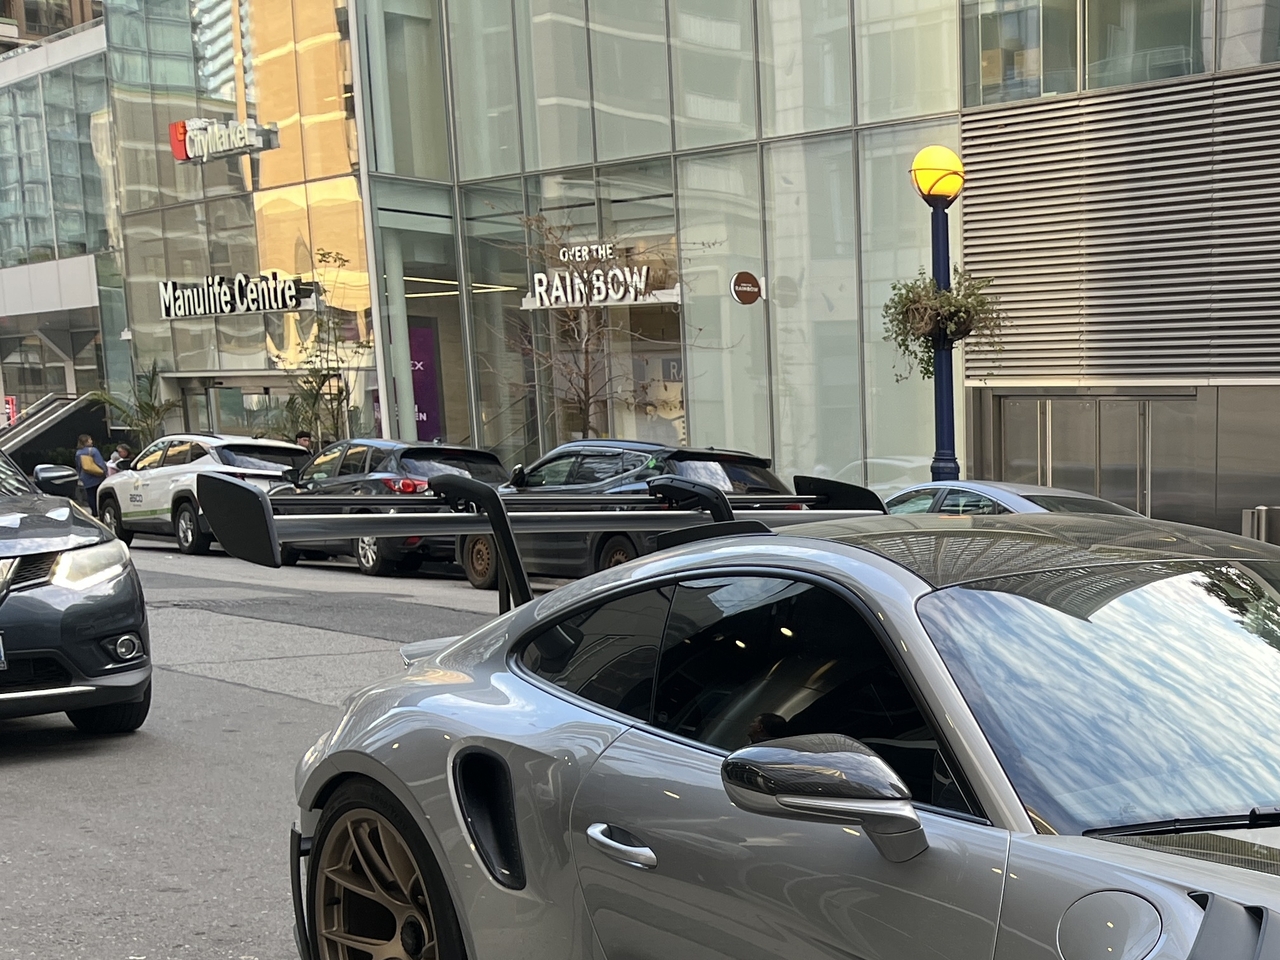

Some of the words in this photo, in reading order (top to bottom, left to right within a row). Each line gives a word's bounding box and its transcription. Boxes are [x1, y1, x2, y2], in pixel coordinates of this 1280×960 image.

[559, 246, 589, 262] OVER
[592, 243, 614, 260] THE
[158, 274, 232, 319] Manulife
[234, 271, 297, 312] Centre
[533, 265, 650, 307] RAINBOW
